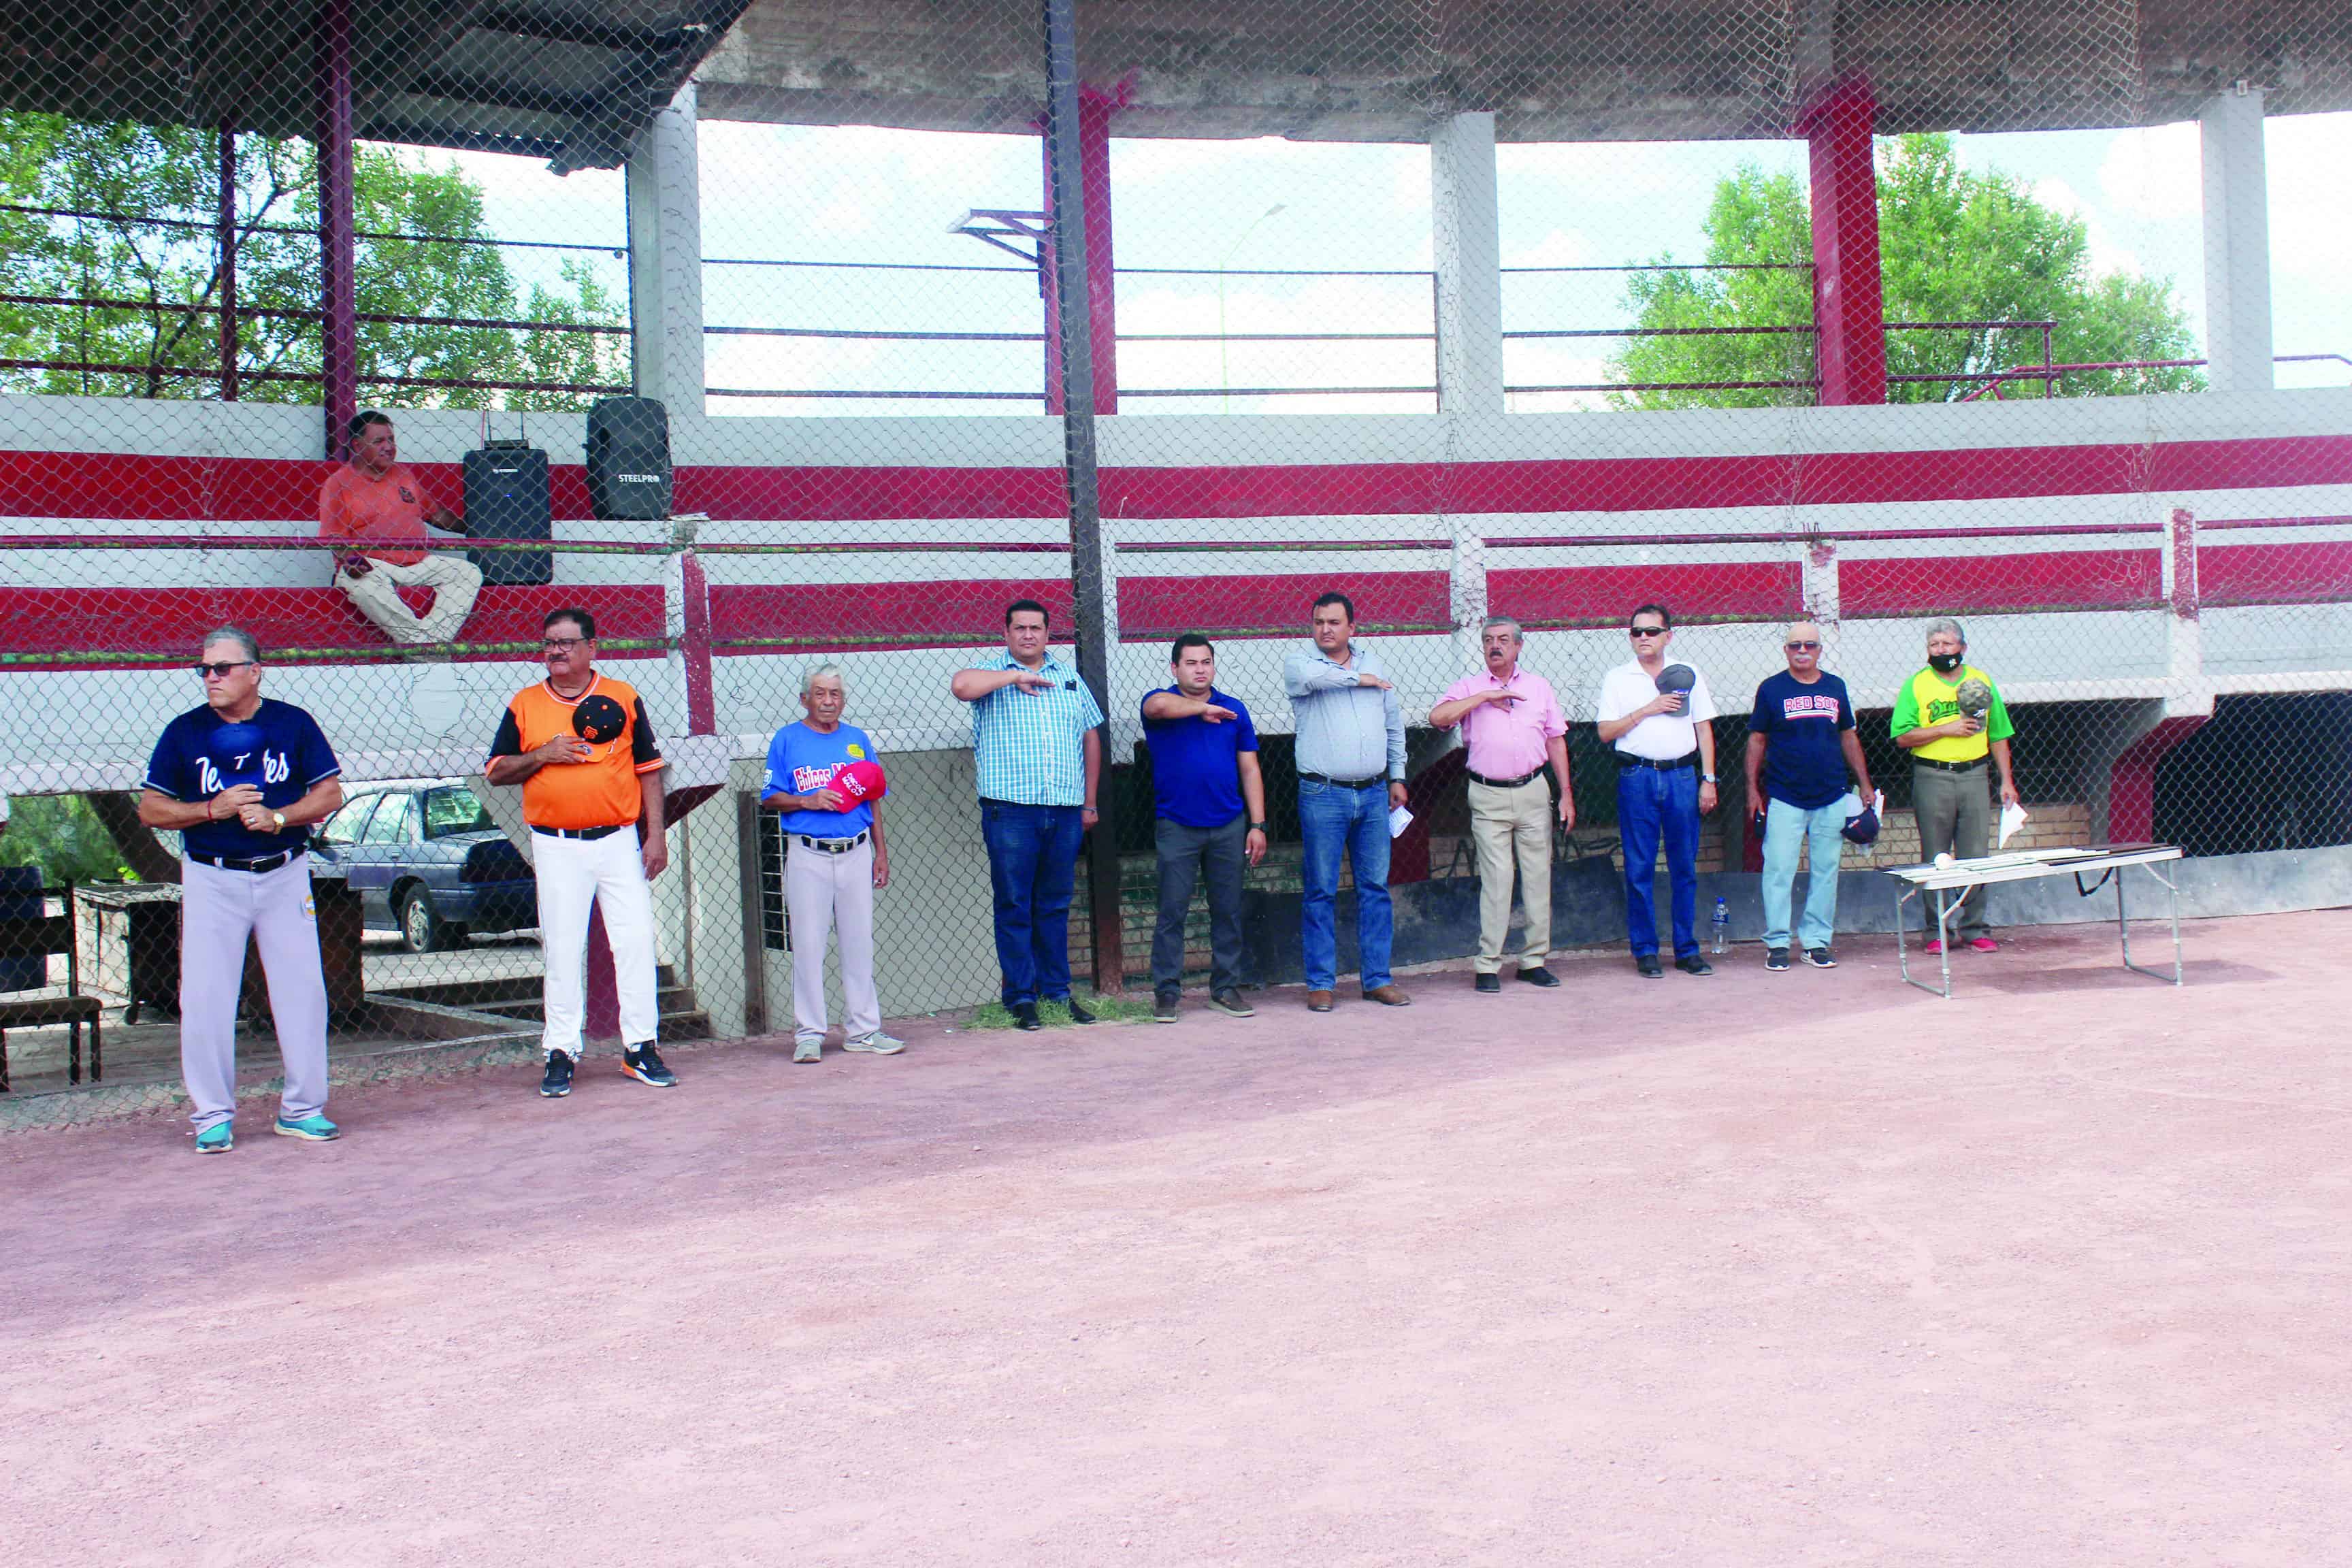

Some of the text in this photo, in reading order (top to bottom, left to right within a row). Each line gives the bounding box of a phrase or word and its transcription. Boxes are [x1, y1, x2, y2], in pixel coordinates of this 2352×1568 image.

[619, 474, 659, 483] STEELPRO
[1784, 696, 1839, 712] RED SOX
[793, 766, 832, 793] Chicos
